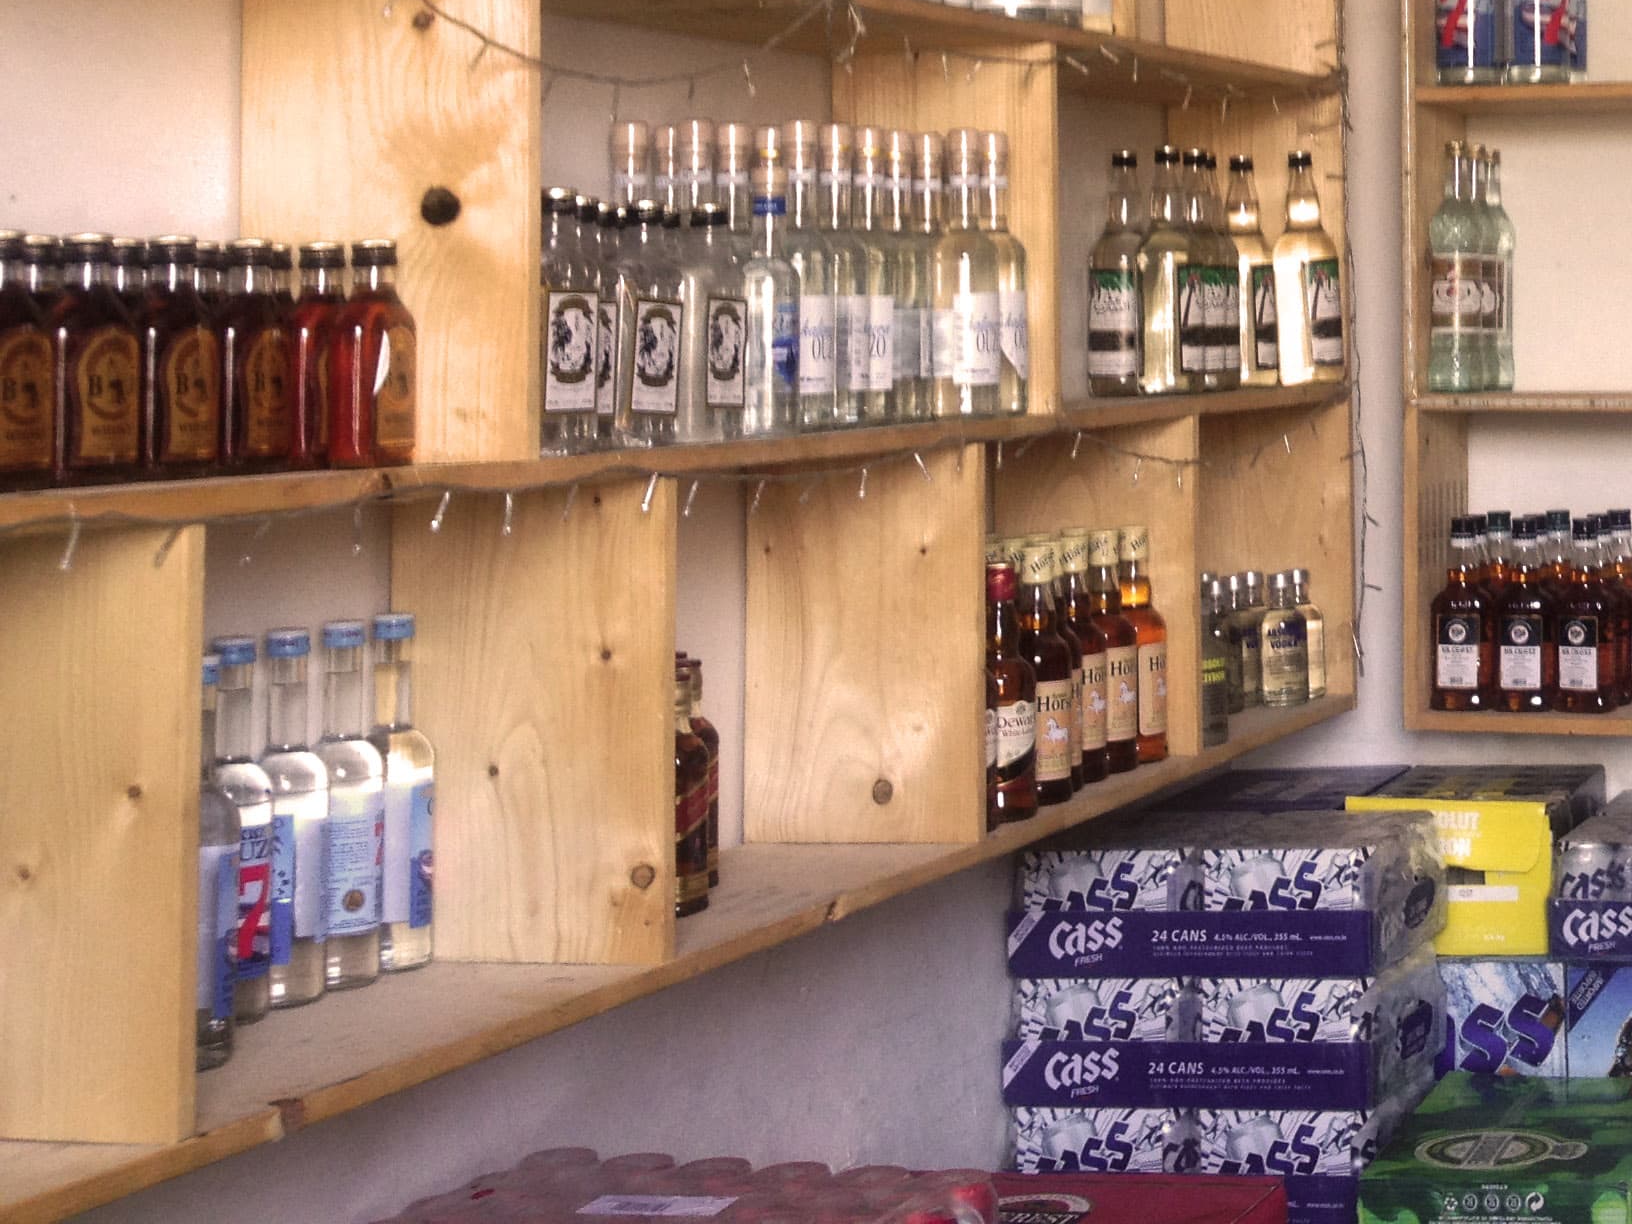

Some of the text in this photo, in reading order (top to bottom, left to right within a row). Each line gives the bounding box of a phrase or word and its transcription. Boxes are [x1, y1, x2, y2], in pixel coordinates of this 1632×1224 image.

[238, 862, 272, 960] 7
[1152, 929, 1168, 943] 24
[1171, 929, 1207, 942] CANS
[1587, 941, 1617, 953] FRESH
[1074, 952, 1104, 968] FRESH
[1148, 1062, 1164, 1075] 24
[1168, 1062, 1204, 1075] CANS
[1070, 1084, 1100, 1098] FRESH
